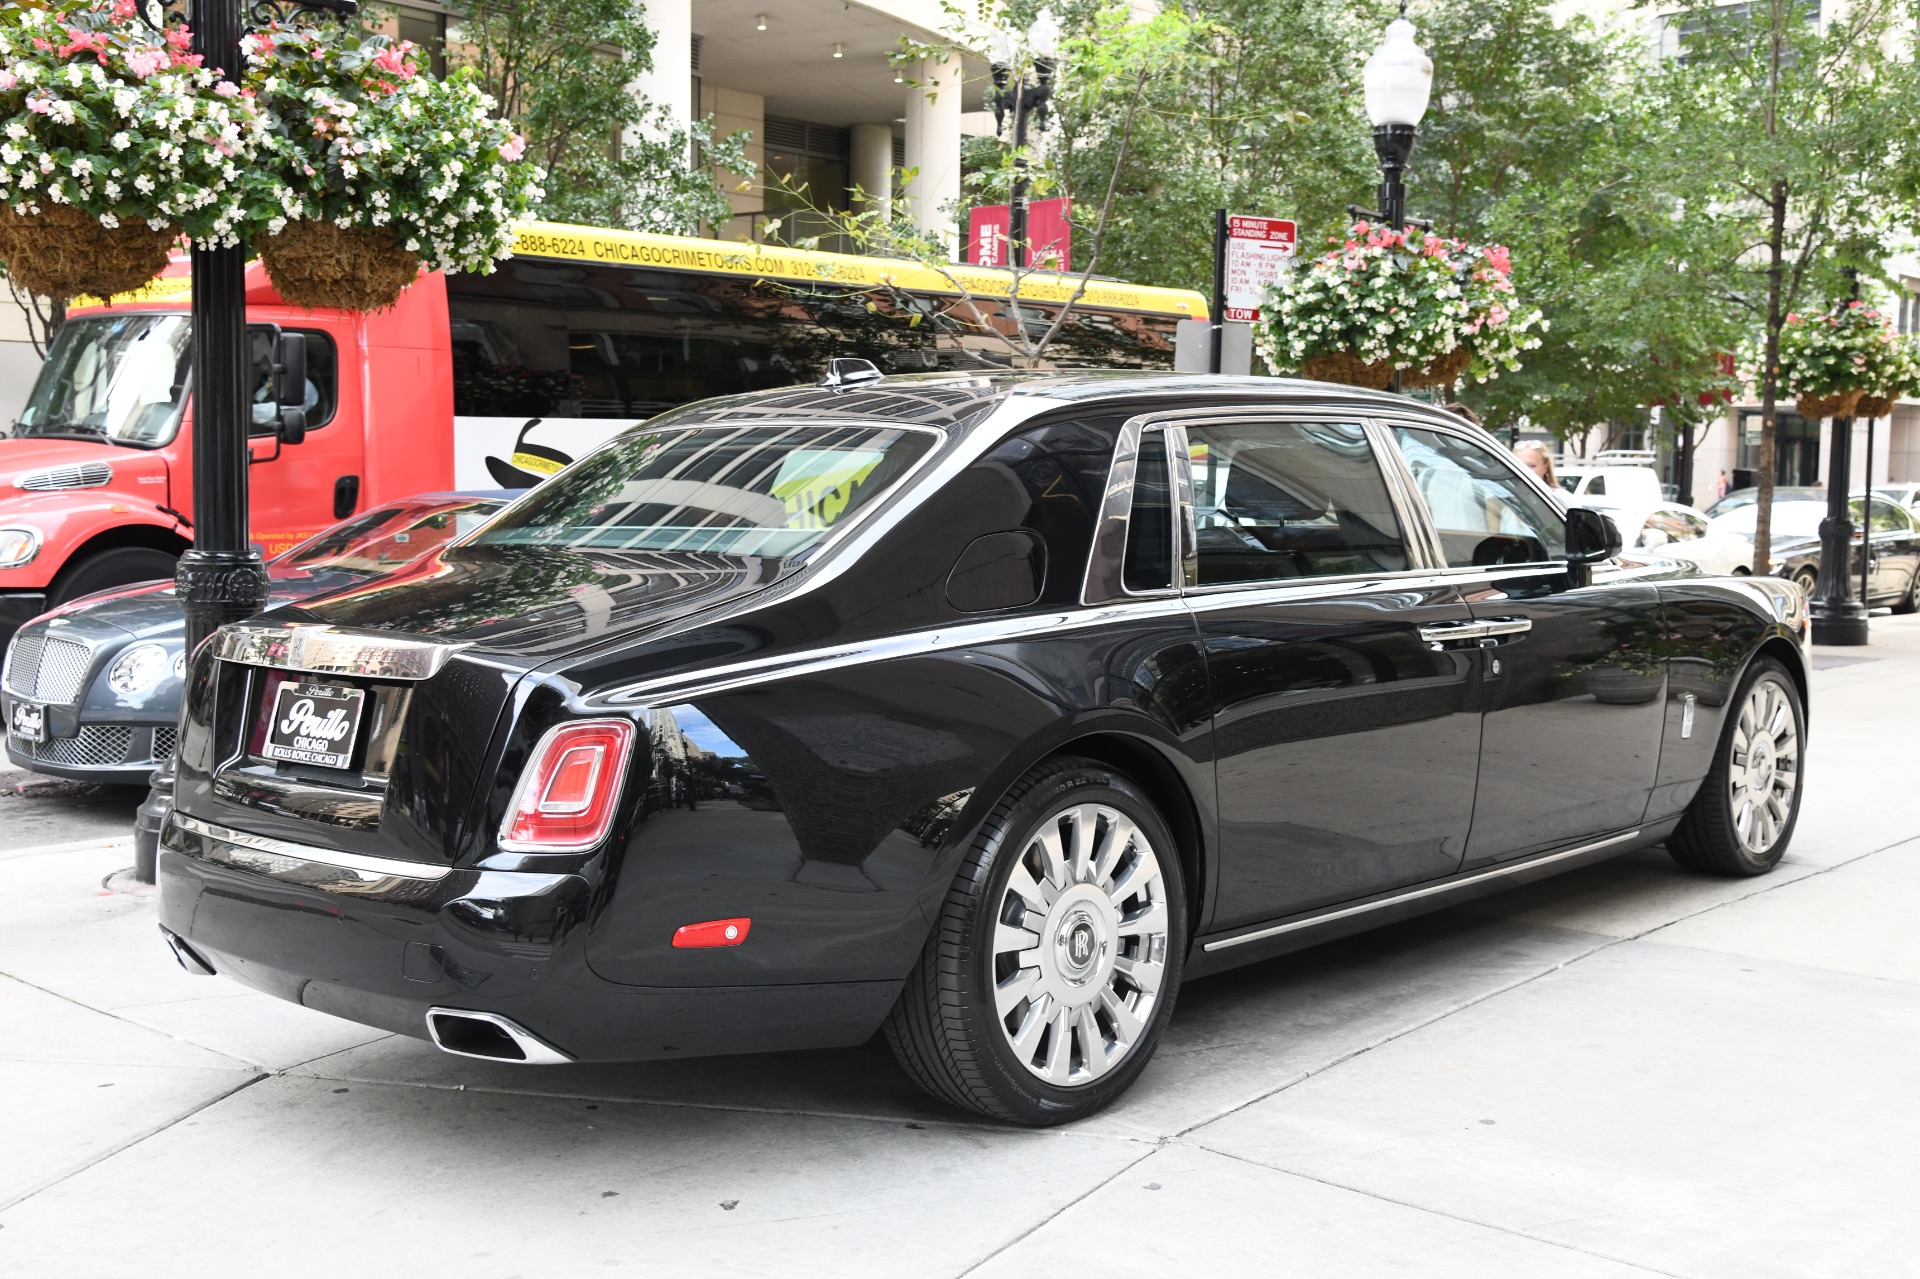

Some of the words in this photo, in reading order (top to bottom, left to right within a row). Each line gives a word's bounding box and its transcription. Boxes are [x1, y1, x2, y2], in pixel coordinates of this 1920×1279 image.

[1232, 219, 1240, 227] 15
[1242, 221, 1268, 230] MINUTE
[1232, 228, 1267, 239] STANDING
[1270, 231, 1288, 240] ZONE
[509, 234, 585, 256] -888-6224
[1232, 243, 1245, 251] USE
[1231, 251, 1265, 260] FLASHING
[1231, 260, 1239, 268] 10
[1255, 271, 1278, 279] THURS
[1240, 277, 1249, 285] AM
[1230, 285, 1242, 293] FRI
[1230, 308, 1253, 320] TOW
[269, 543, 301, 555] USD
[293, 736, 329, 752] CHICAGO
[274, 748, 292, 758] ROLLS
[292, 750, 311, 760] ROYCE
[311, 753, 337, 765] CHICAGO
